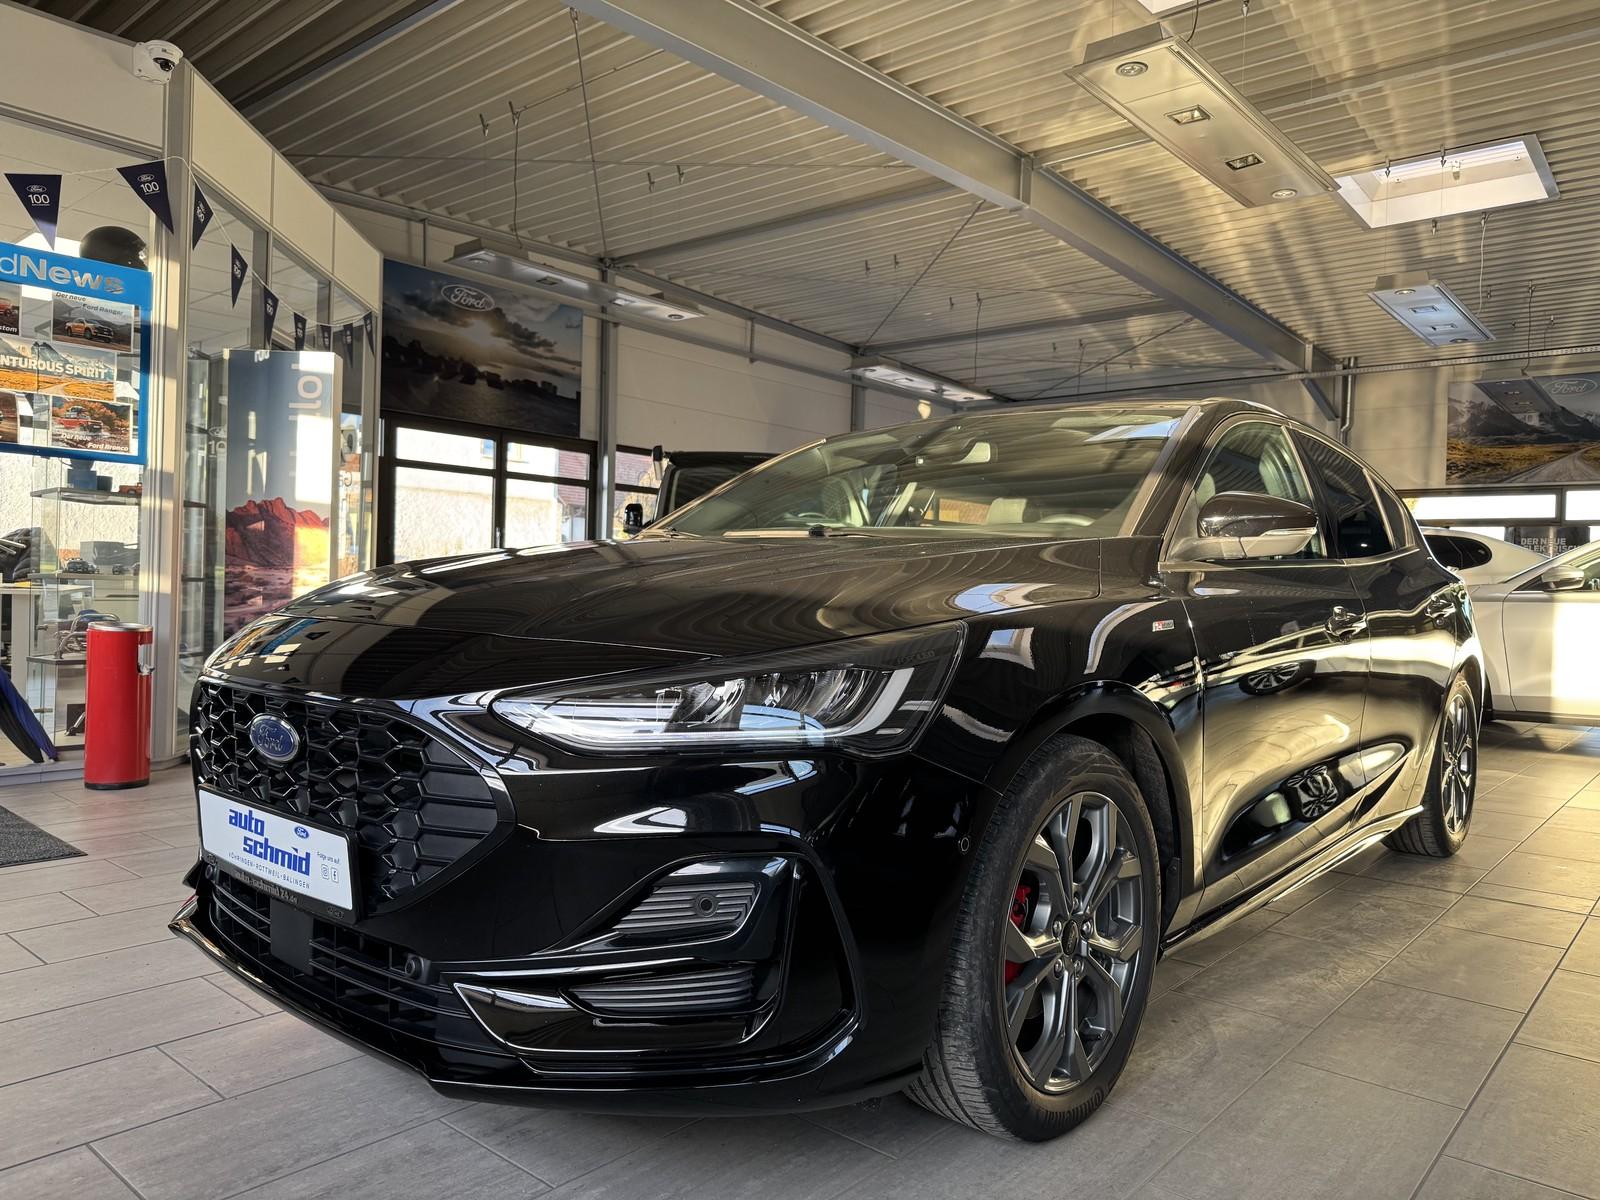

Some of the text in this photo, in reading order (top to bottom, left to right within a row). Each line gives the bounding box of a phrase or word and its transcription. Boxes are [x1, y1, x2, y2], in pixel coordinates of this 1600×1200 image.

[140, 182, 160, 193] 100
[28, 194, 50, 204] 100
[55, 291, 68, 300] Der
[82, 303, 124, 316] Ford Ranger
[65, 364, 108, 379] SPIRIT
[87, 442, 129, 452] Ford Bronco
[1521, 537, 1539, 545] DER
[229, 809, 265, 837] auto
[243, 836, 311, 876] schmid
